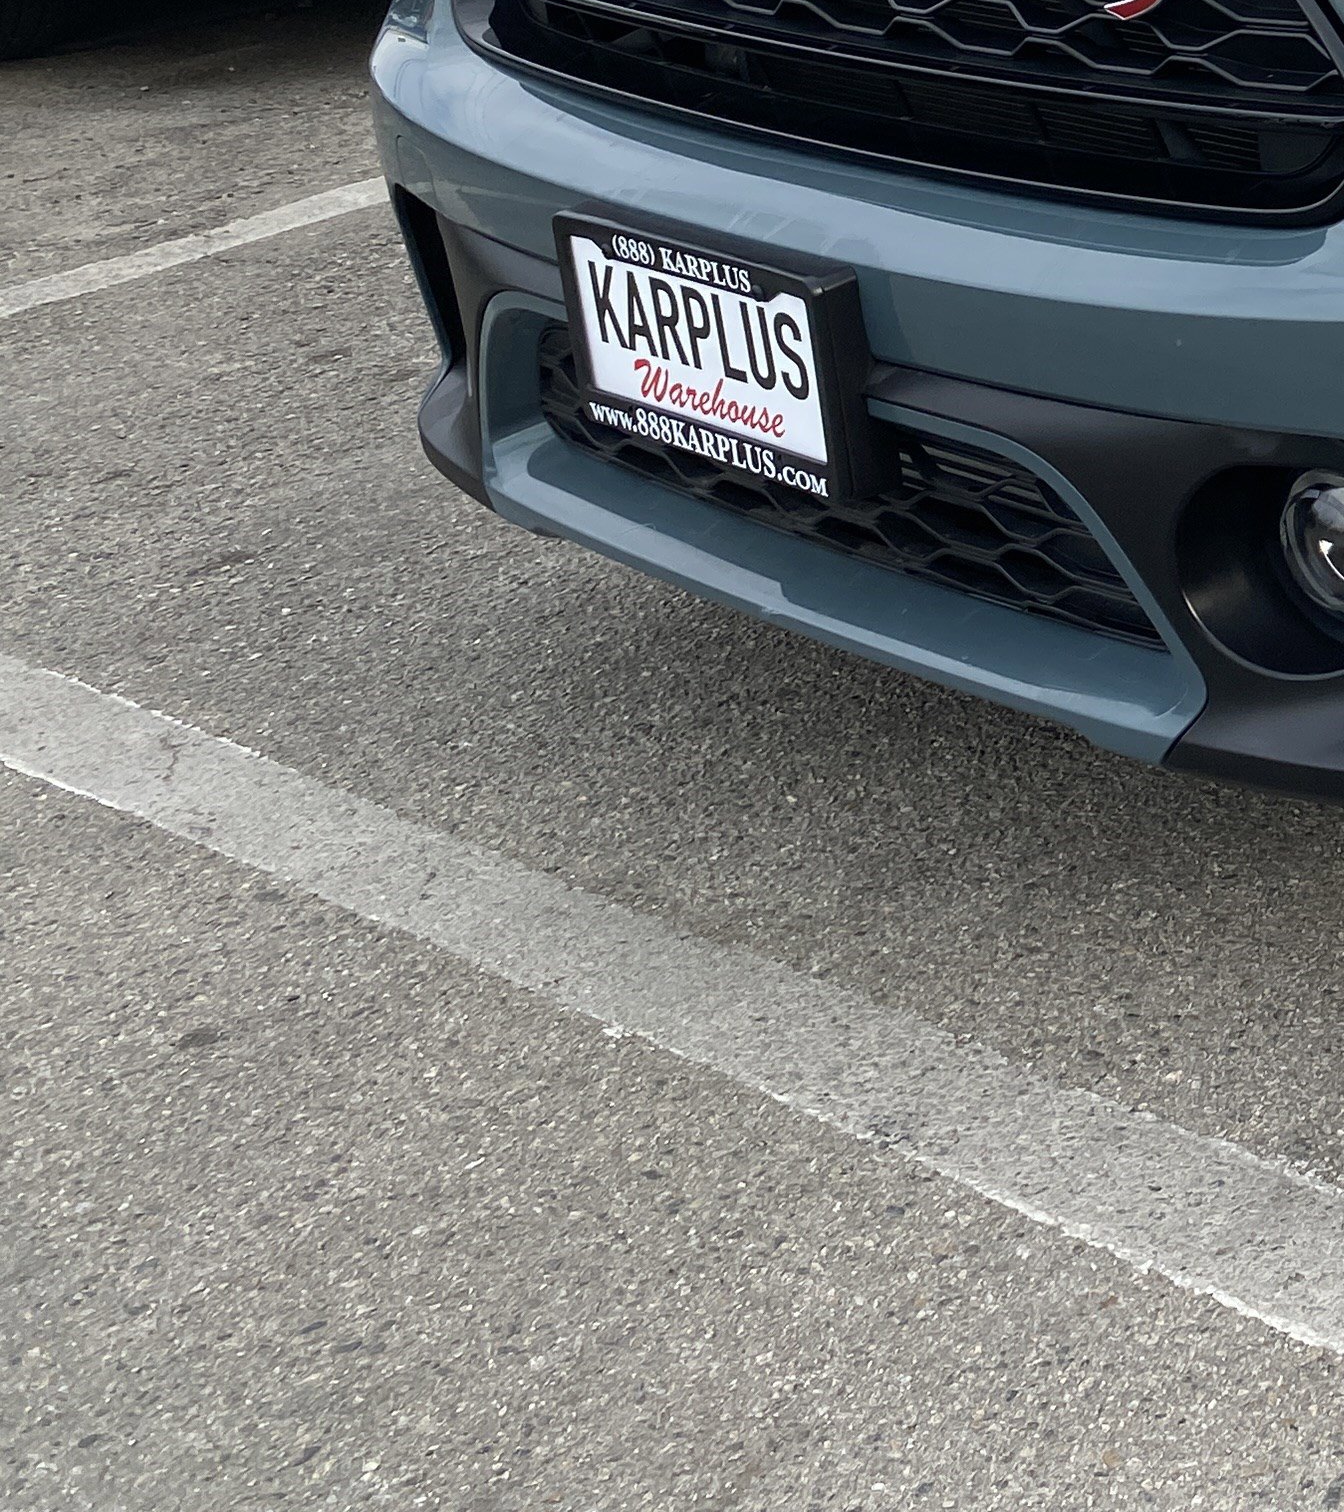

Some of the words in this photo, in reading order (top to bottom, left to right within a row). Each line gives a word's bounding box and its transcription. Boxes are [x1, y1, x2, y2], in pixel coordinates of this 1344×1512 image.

[611, 234, 655, 266] (888)
[657, 246, 751, 293] KARPLUS
[587, 259, 810, 401] KARPLUS
[633, 358, 785, 438] Warehouse
